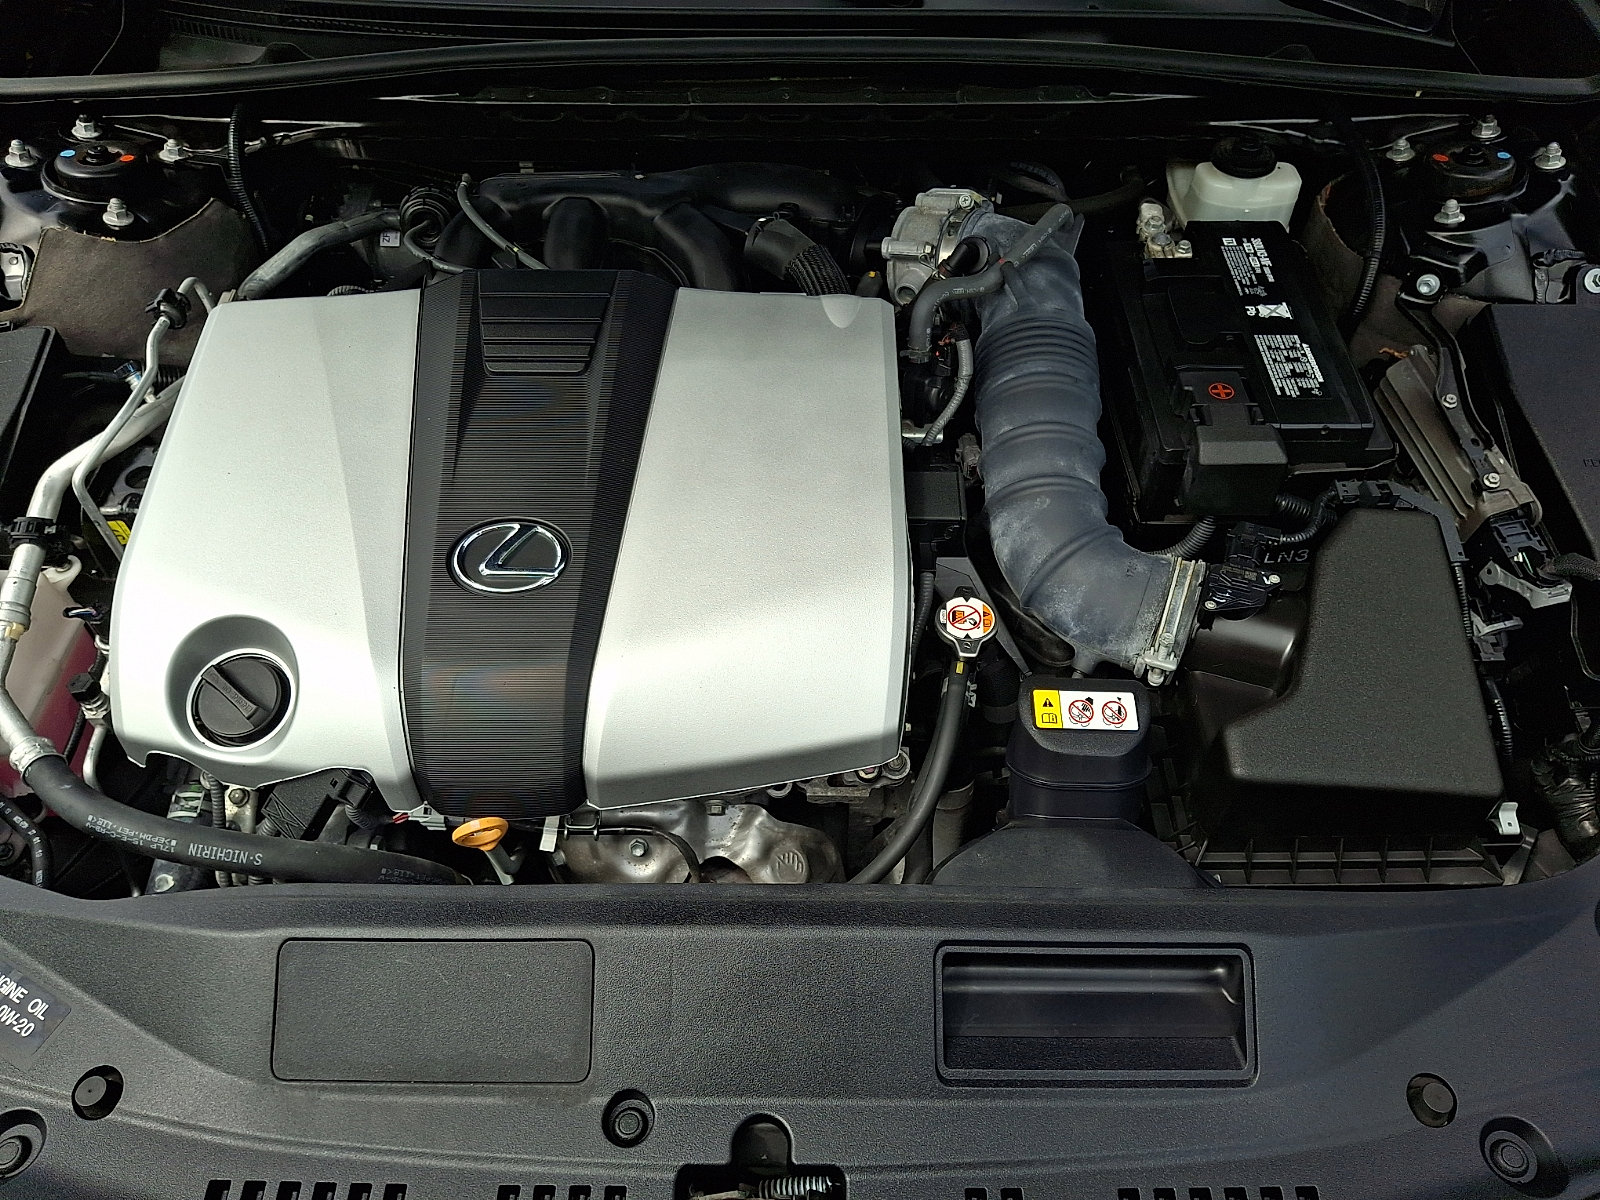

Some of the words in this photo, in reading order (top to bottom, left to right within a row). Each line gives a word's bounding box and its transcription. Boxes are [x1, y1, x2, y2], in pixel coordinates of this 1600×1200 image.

[1244, 305, 1257, 317] Pb
[1264, 549, 1309, 564] LN3
[27, 998, 49, 1021] OIL
